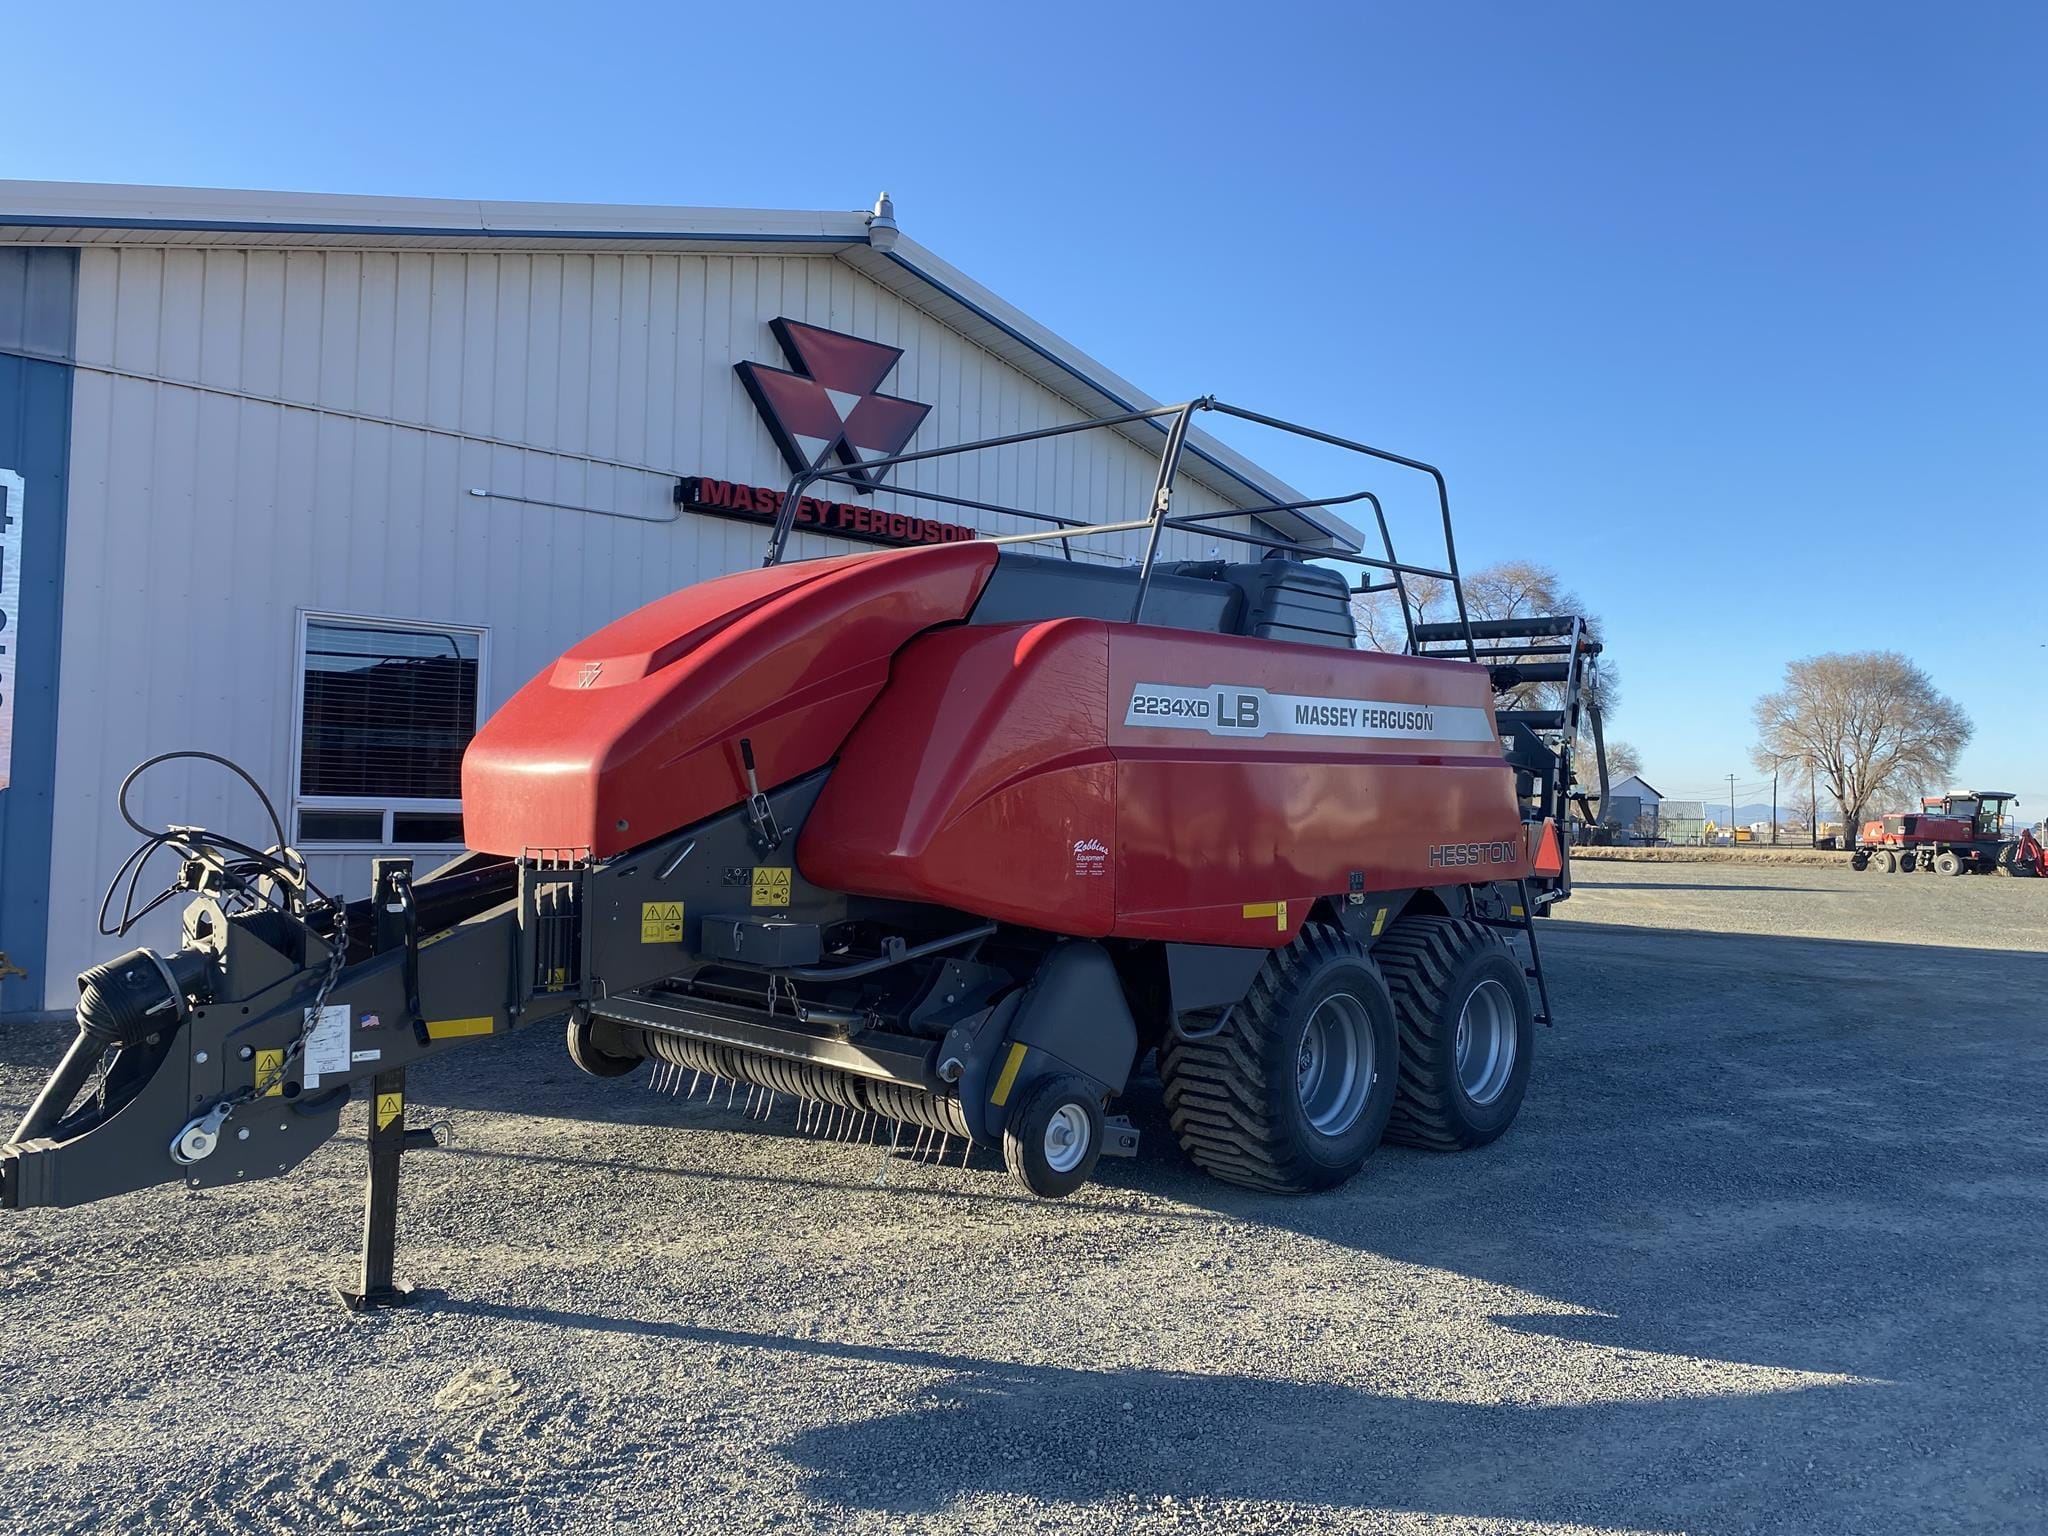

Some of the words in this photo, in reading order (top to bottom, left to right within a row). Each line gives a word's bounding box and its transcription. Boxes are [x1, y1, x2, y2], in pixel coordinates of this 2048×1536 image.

[1133, 696, 1210, 718] 2234XD
[1217, 692, 1260, 728] LB
[1295, 704, 1358, 727] MASSEY
[1362, 709, 1433, 731] FERGUSON
[1073, 839, 1109, 856] Robbins
[1076, 854, 1105, 862] Equipment
[1428, 841, 1517, 868] HESSTON
